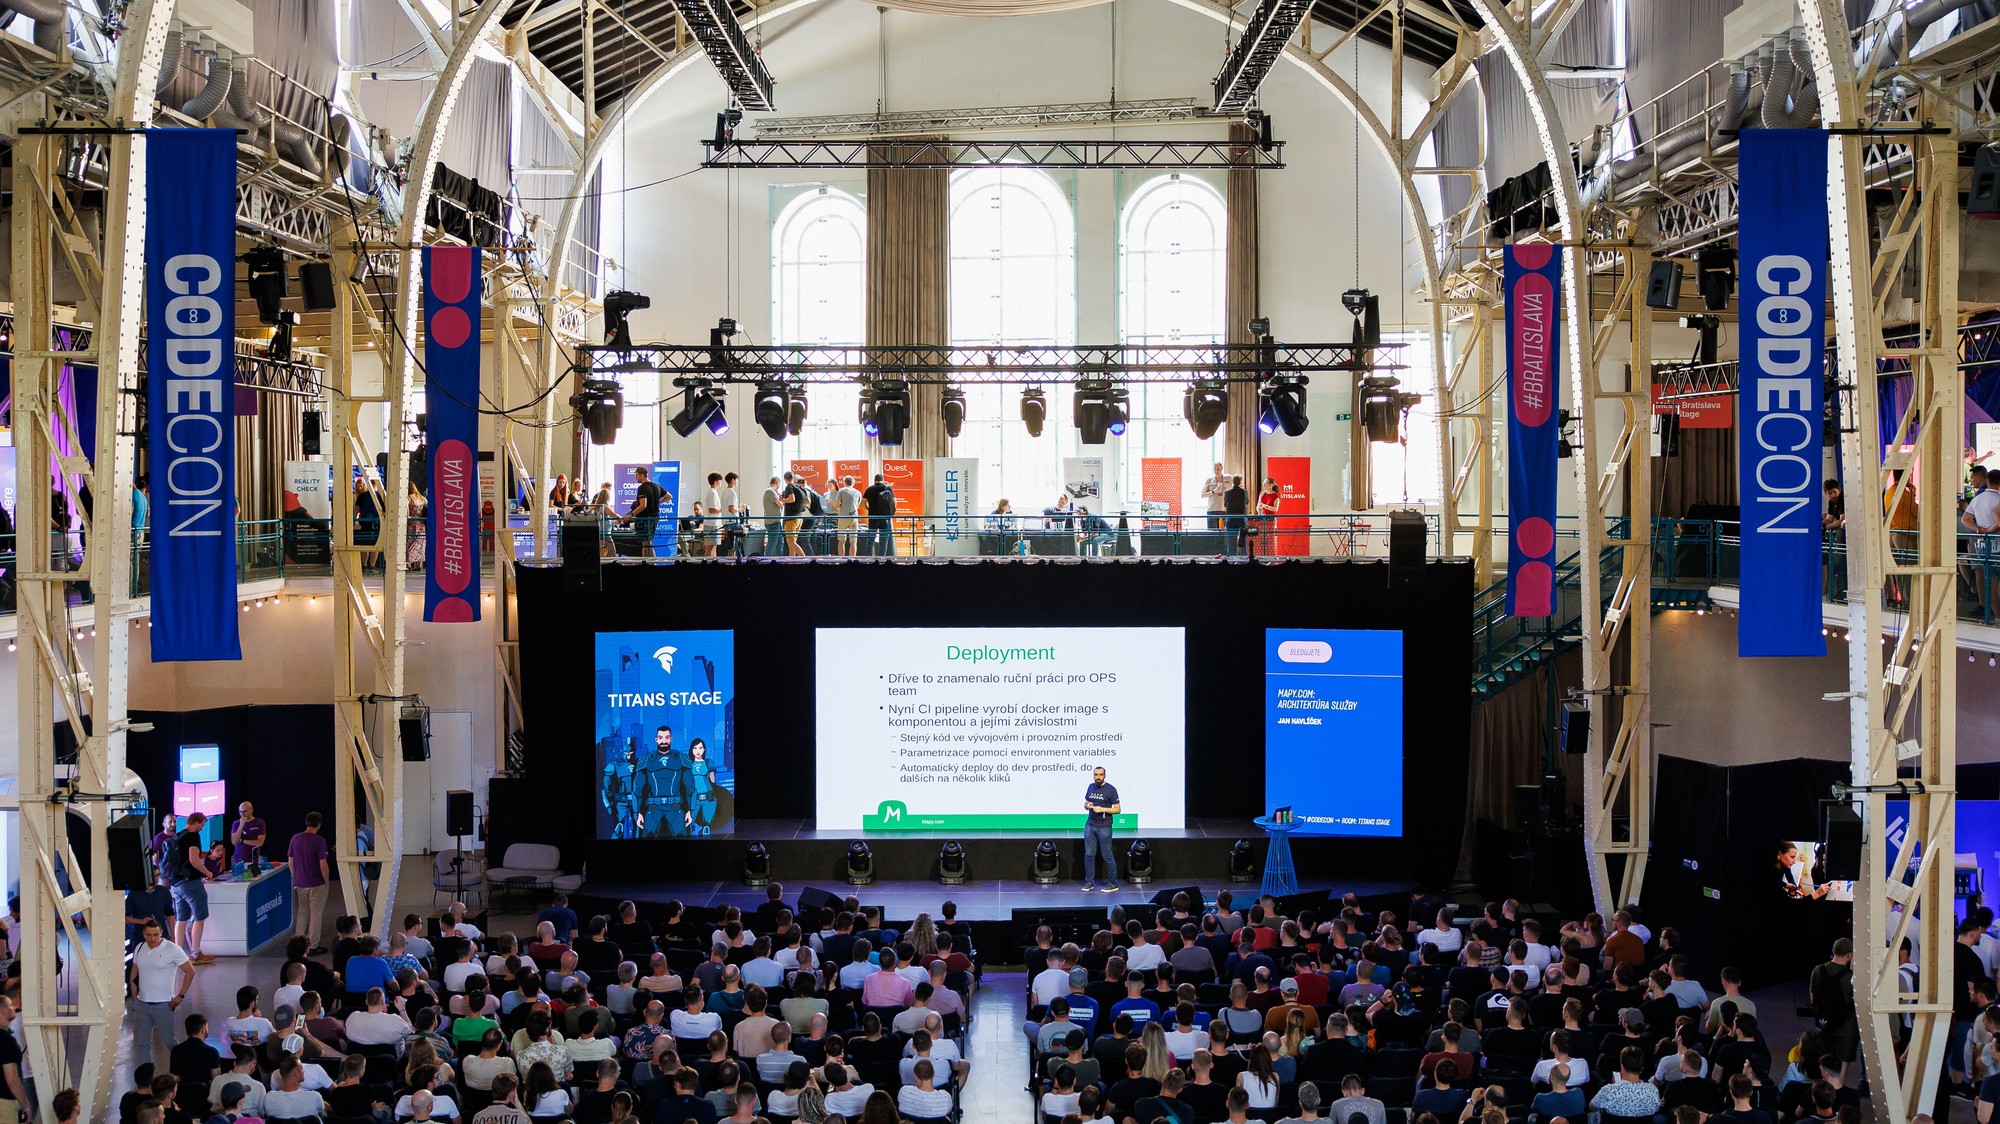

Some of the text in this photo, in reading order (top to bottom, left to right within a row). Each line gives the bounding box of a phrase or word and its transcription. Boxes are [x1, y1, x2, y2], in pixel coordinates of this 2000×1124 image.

[1523, 293, 1544, 409] #BRATISLAVA
[164, 254, 223, 537] CODECON
[1756, 254, 1812, 534] CODECON
[1682, 401, 1721, 409] Bratislava
[792, 463, 814, 472] Quest
[840, 463, 861, 471] Quest
[884, 463, 908, 472] Quest
[946, 470, 958, 542] KISTLER
[443, 459, 464, 576] #BRATISLAVA
[947, 645, 1055, 664] Deployment
[1290, 648, 1321, 656] SLEDUJETE
[888, 673, 1117, 685] Dříve to znamenalo ruční práci pro OPS
[888, 687, 917, 696] team
[1277, 689, 1316, 698] MAPY.COM:
[607, 691, 722, 707] TITANS STAGE
[1277, 699, 1358, 710] ARCHITEKTÚRA SLUŽBY
[888, 704, 1109, 716] Nyní CI pipeline vyrobí docker image s
[888, 716, 1077, 729] komponentou a jejími závislostmi
[1291, 717, 1322, 725] HAVLÍČEK
[900, 733, 930, 744] Stejný
[933, 733, 951, 742] kód
[953, 734, 965, 742] ve
[968, 733, 1019, 744] vývojovém
[1027, 733, 1077, 744] provozním
[1080, 733, 1123, 744] prostředí
[900, 748, 1117, 758] Parametrizace pomocí environment variables
[900, 763, 1093, 774] Automatický deploy do dev prostředí, do
[900, 773, 1011, 783] dalších na několik kliků
[1341, 817, 1358, 825] ROOM:
[1375, 818, 1391, 826] STAGE
